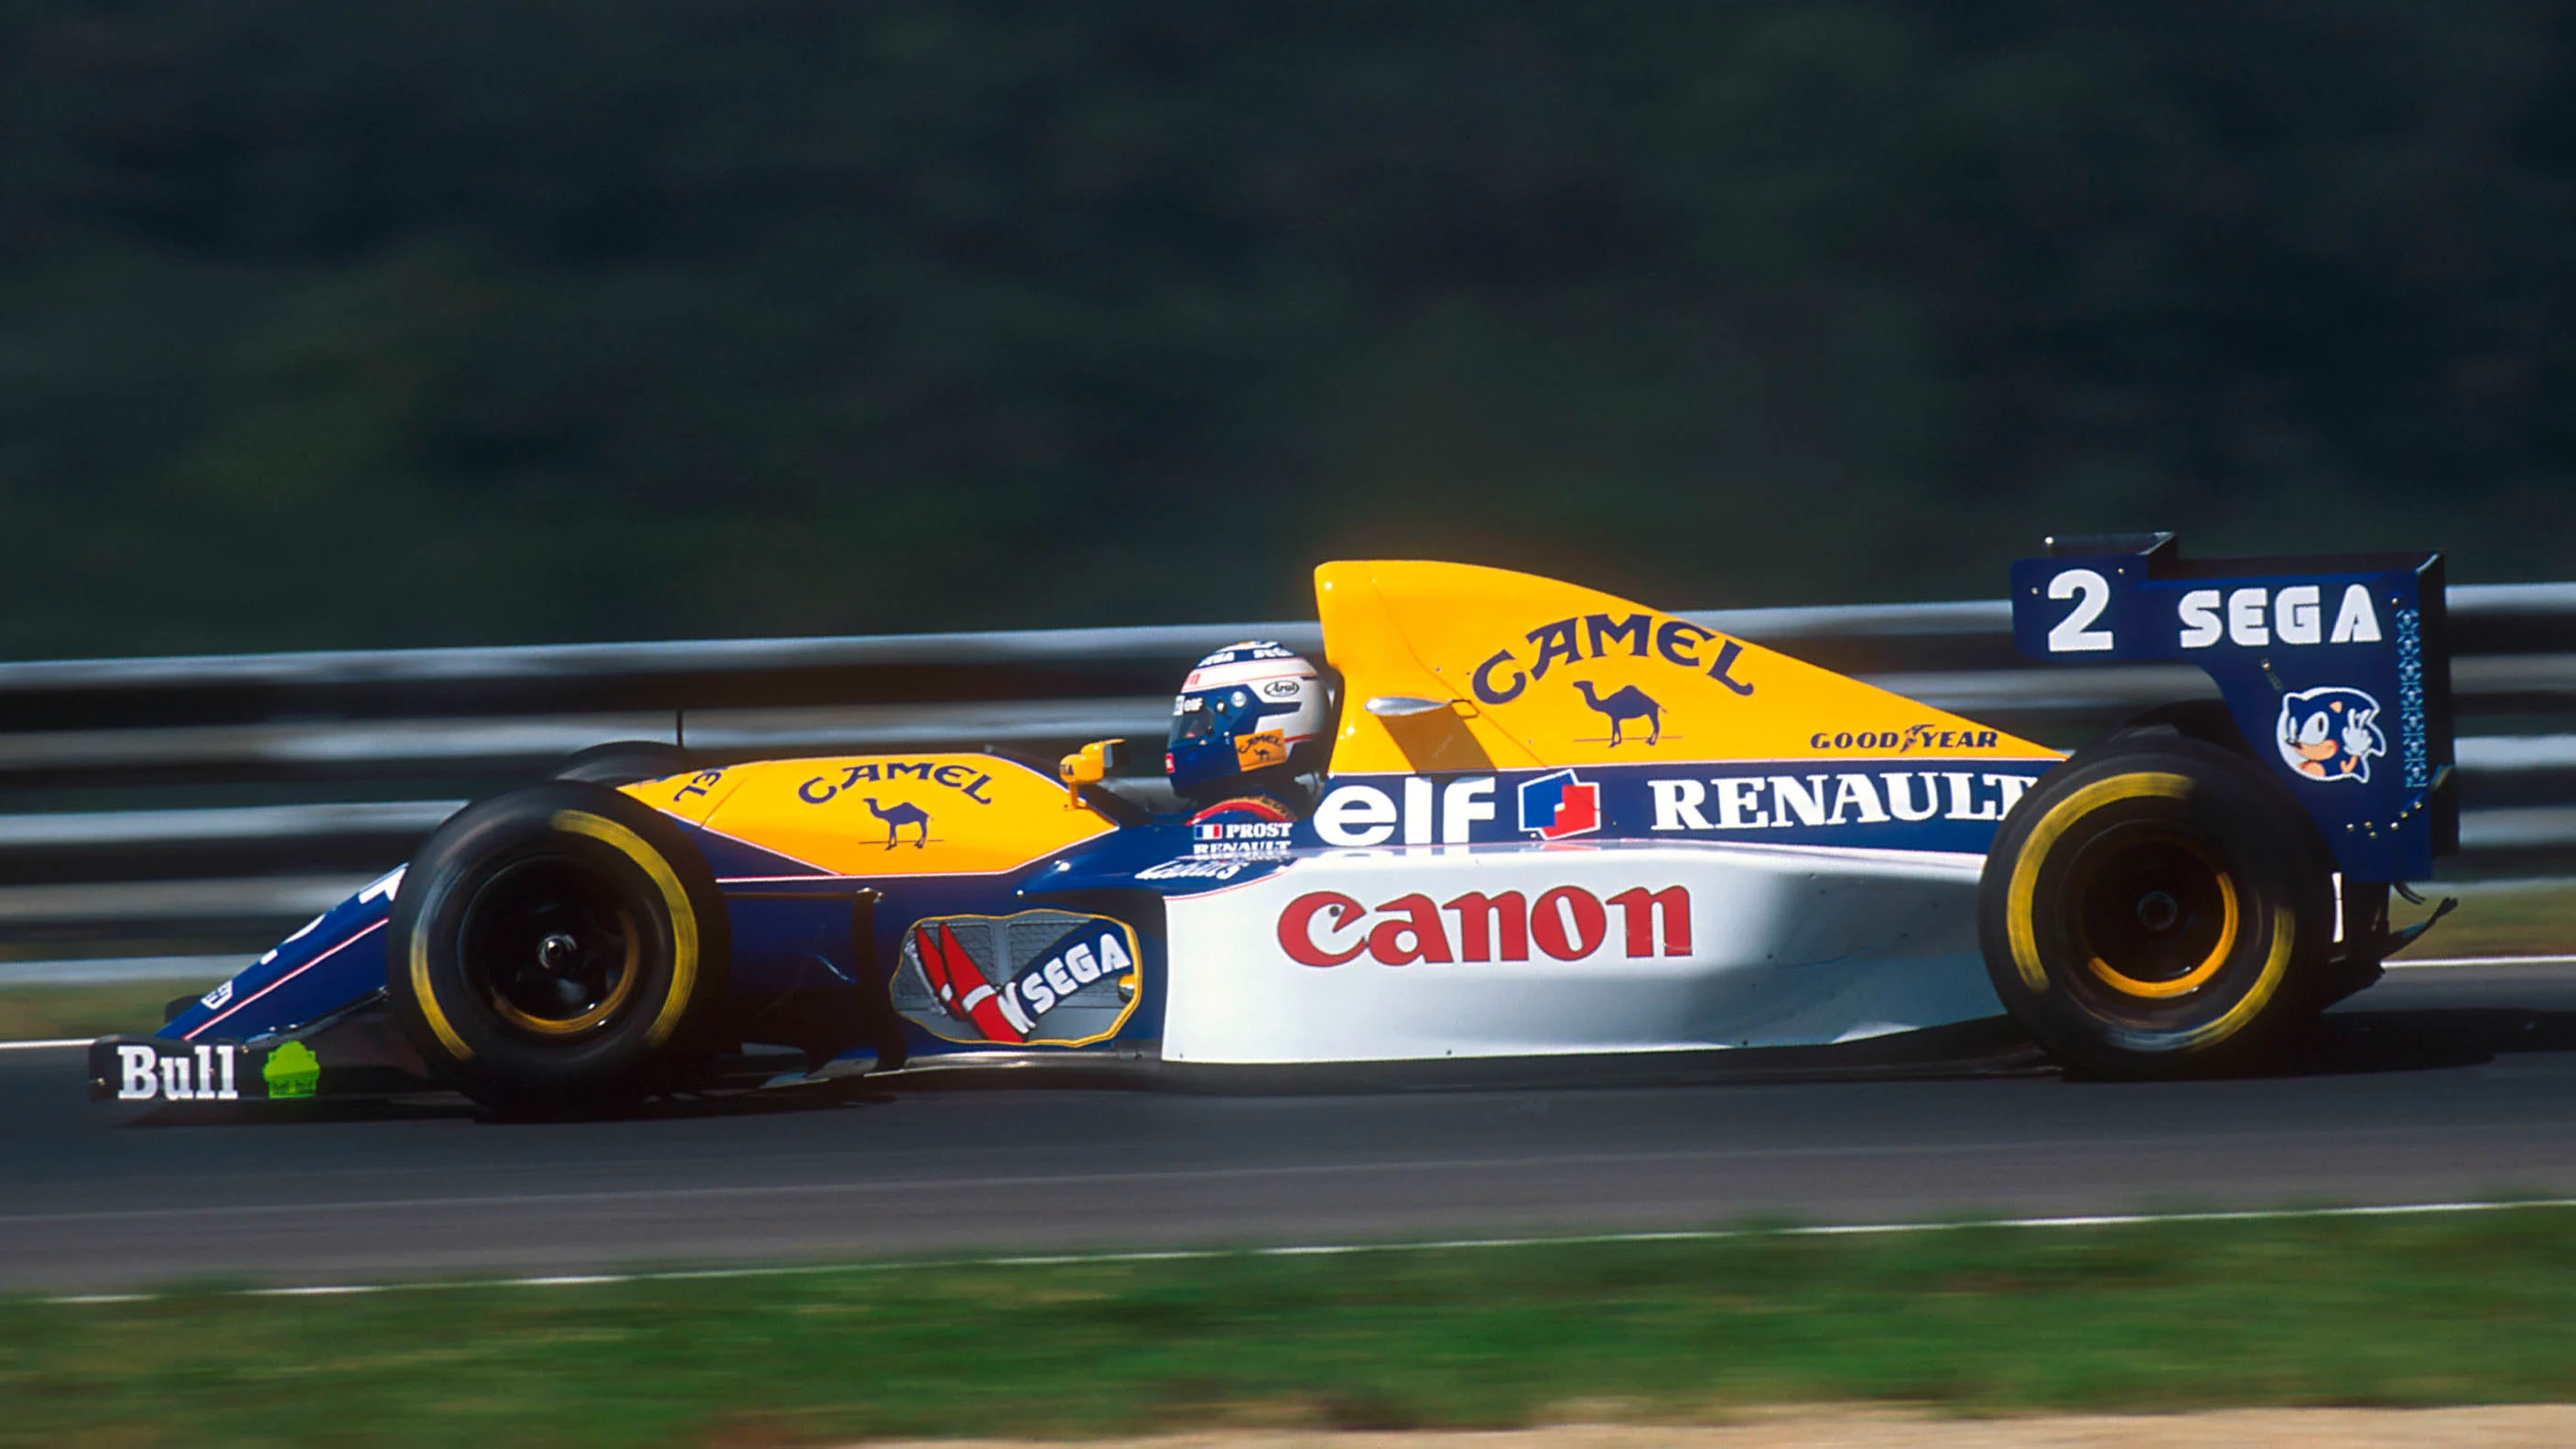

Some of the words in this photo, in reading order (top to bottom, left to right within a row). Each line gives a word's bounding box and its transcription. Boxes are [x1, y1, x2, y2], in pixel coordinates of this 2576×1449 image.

[2048, 569, 2114, 652] 2
[2178, 584, 2382, 648] SEGA
[1472, 613, 1754, 704] CAMEL
[797, 762, 992, 805] CAMEL
[1314, 775, 1497, 847] elf
[1649, 772, 2039, 831] RENAULT
[1193, 840, 1293, 856] RENAULT
[1226, 822, 1293, 838] PROST
[1277, 885, 1693, 968] Canon
[1022, 933, 1131, 1014] SEGA
[117, 1045, 239, 1099] Bull
